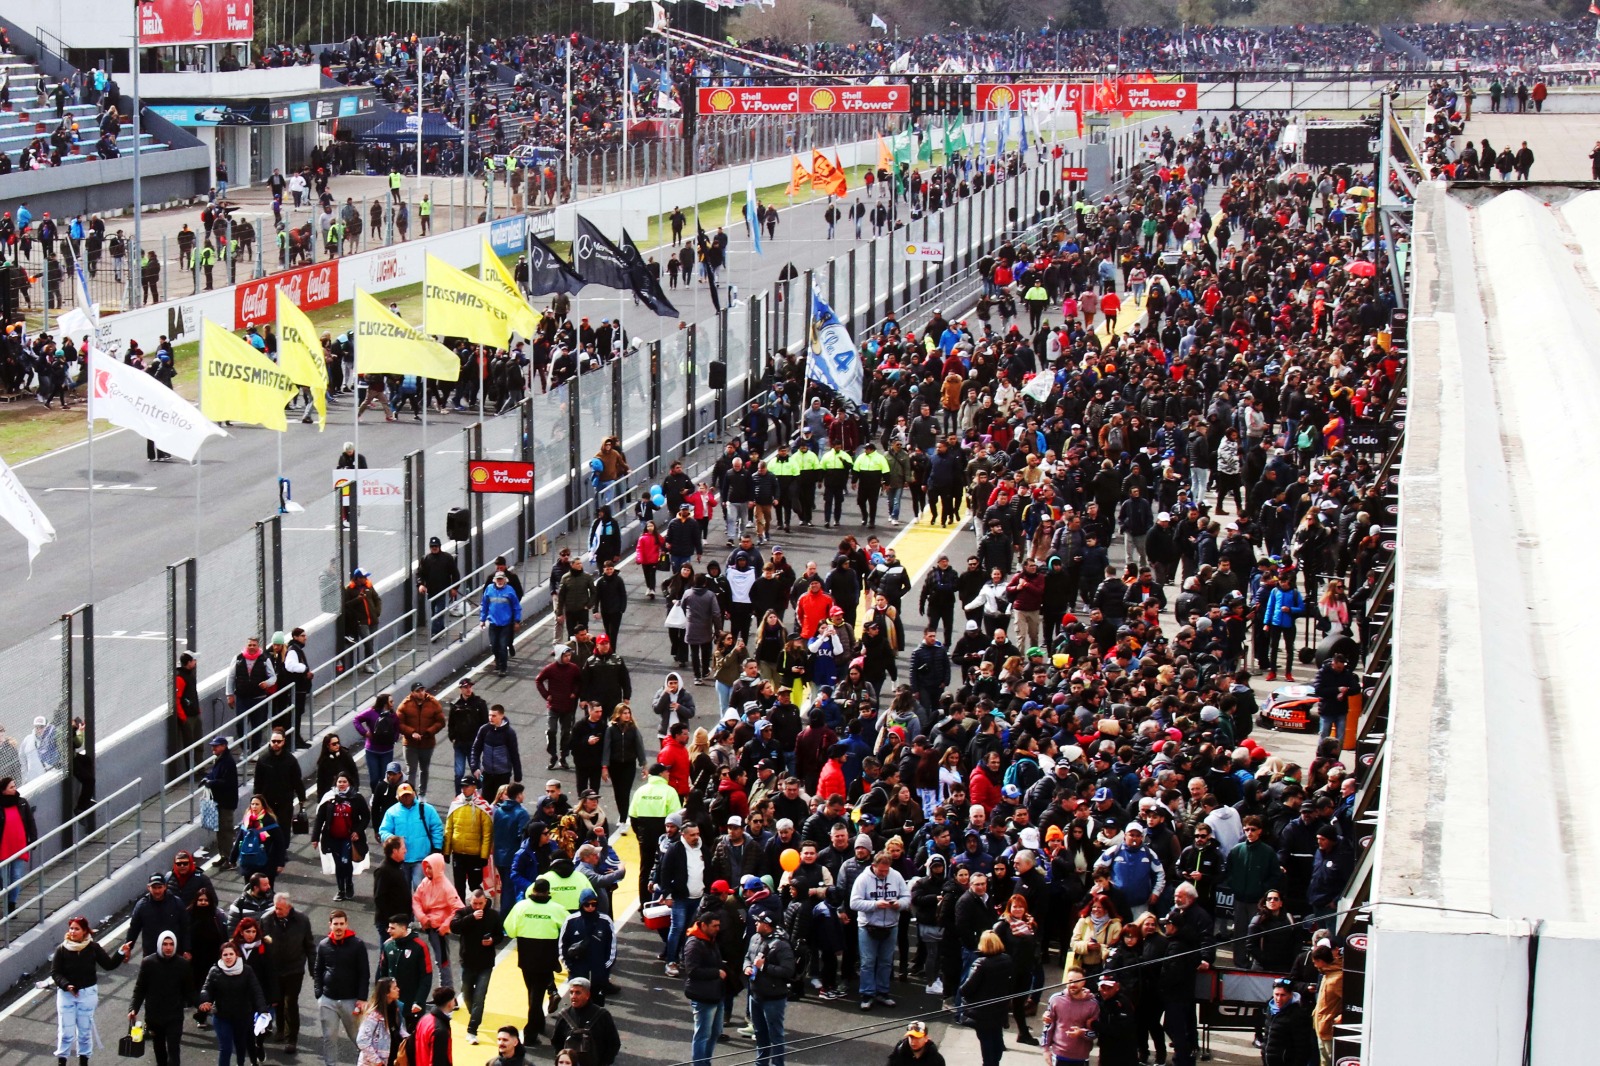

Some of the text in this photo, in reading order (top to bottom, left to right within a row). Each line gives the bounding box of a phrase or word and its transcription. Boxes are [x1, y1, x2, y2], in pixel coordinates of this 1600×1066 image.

[142, 12, 165, 35] HELIX
[226, 16, 249, 31] V-Power
[741, 92, 761, 101] Shell
[841, 91, 862, 100] Shell
[1128, 89, 1149, 97] Shell
[741, 101, 794, 111] V-Power
[842, 100, 894, 110] V-Power
[1129, 98, 1182, 109] V-Power
[376, 257, 398, 283] LUGANO
[833, 350, 855, 374] 4
[362, 479, 380, 487] Shell
[493, 475, 531, 485] V-Power
[362, 482, 401, 496] HELIX
